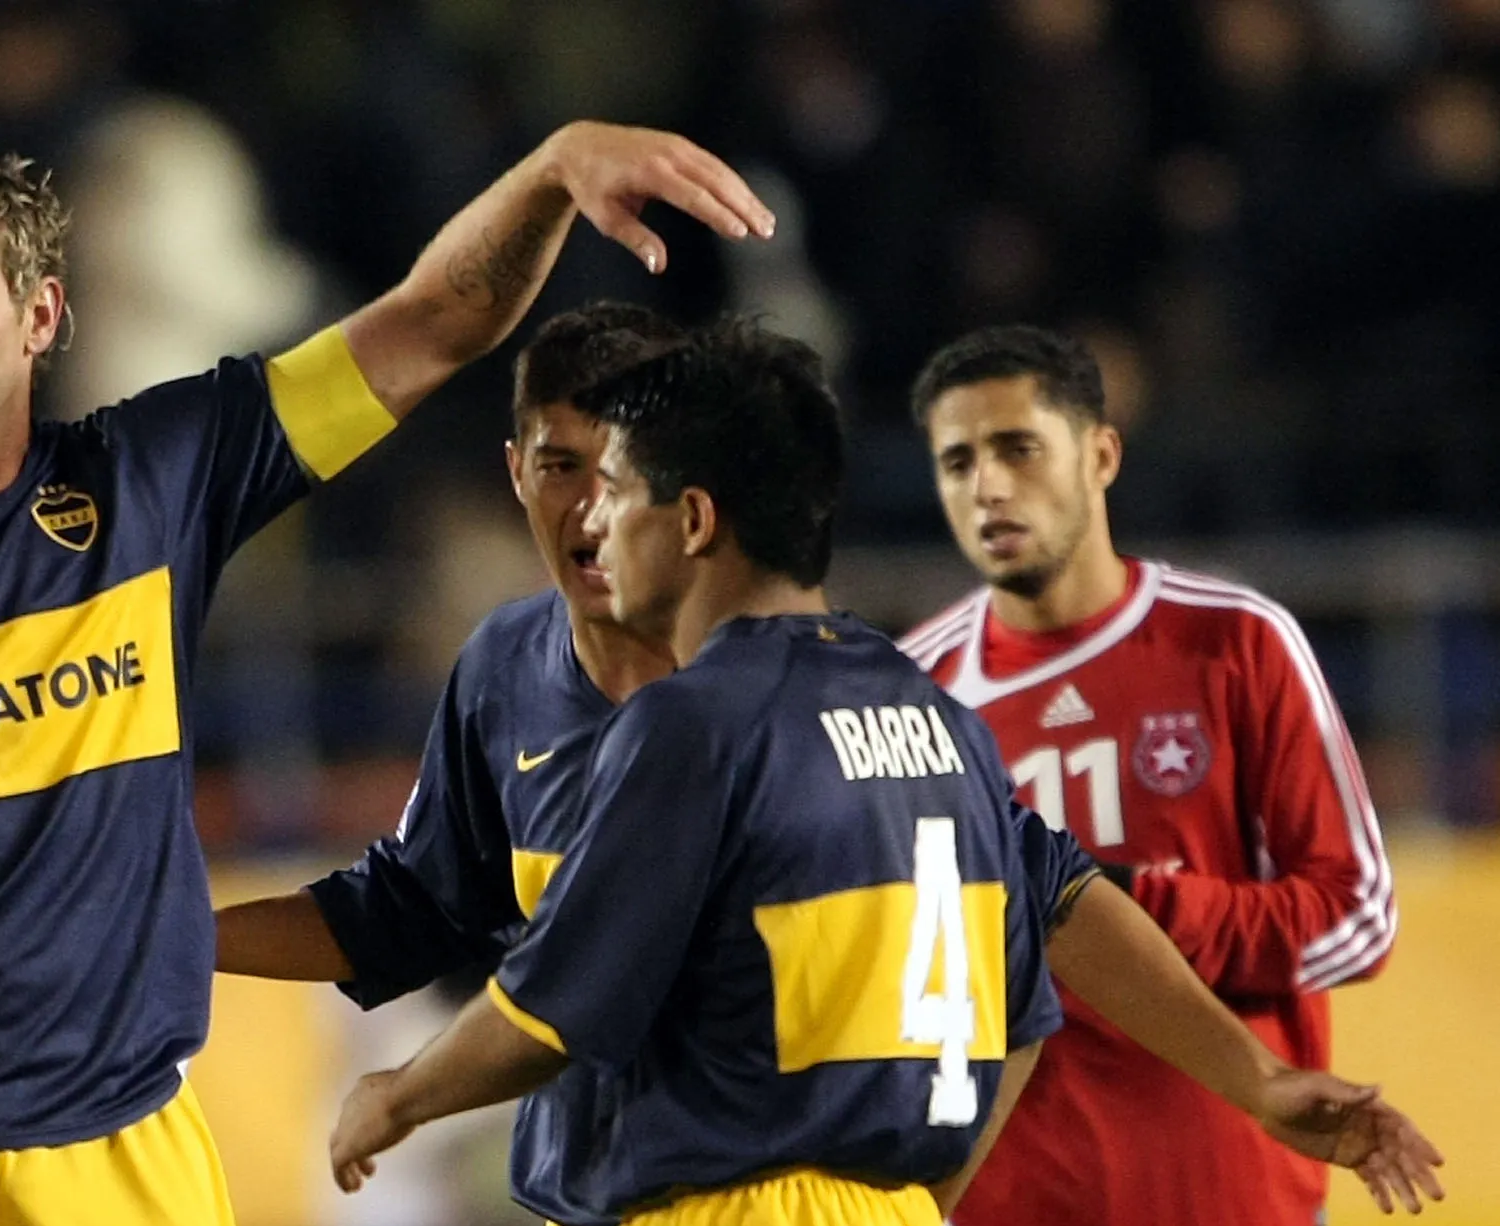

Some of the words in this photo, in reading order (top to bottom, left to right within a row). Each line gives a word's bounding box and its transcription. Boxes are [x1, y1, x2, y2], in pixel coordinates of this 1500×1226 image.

[820, 705, 965, 780] IBARRA
[1011, 738, 1125, 846] 11
[900, 817, 977, 1126] 4
